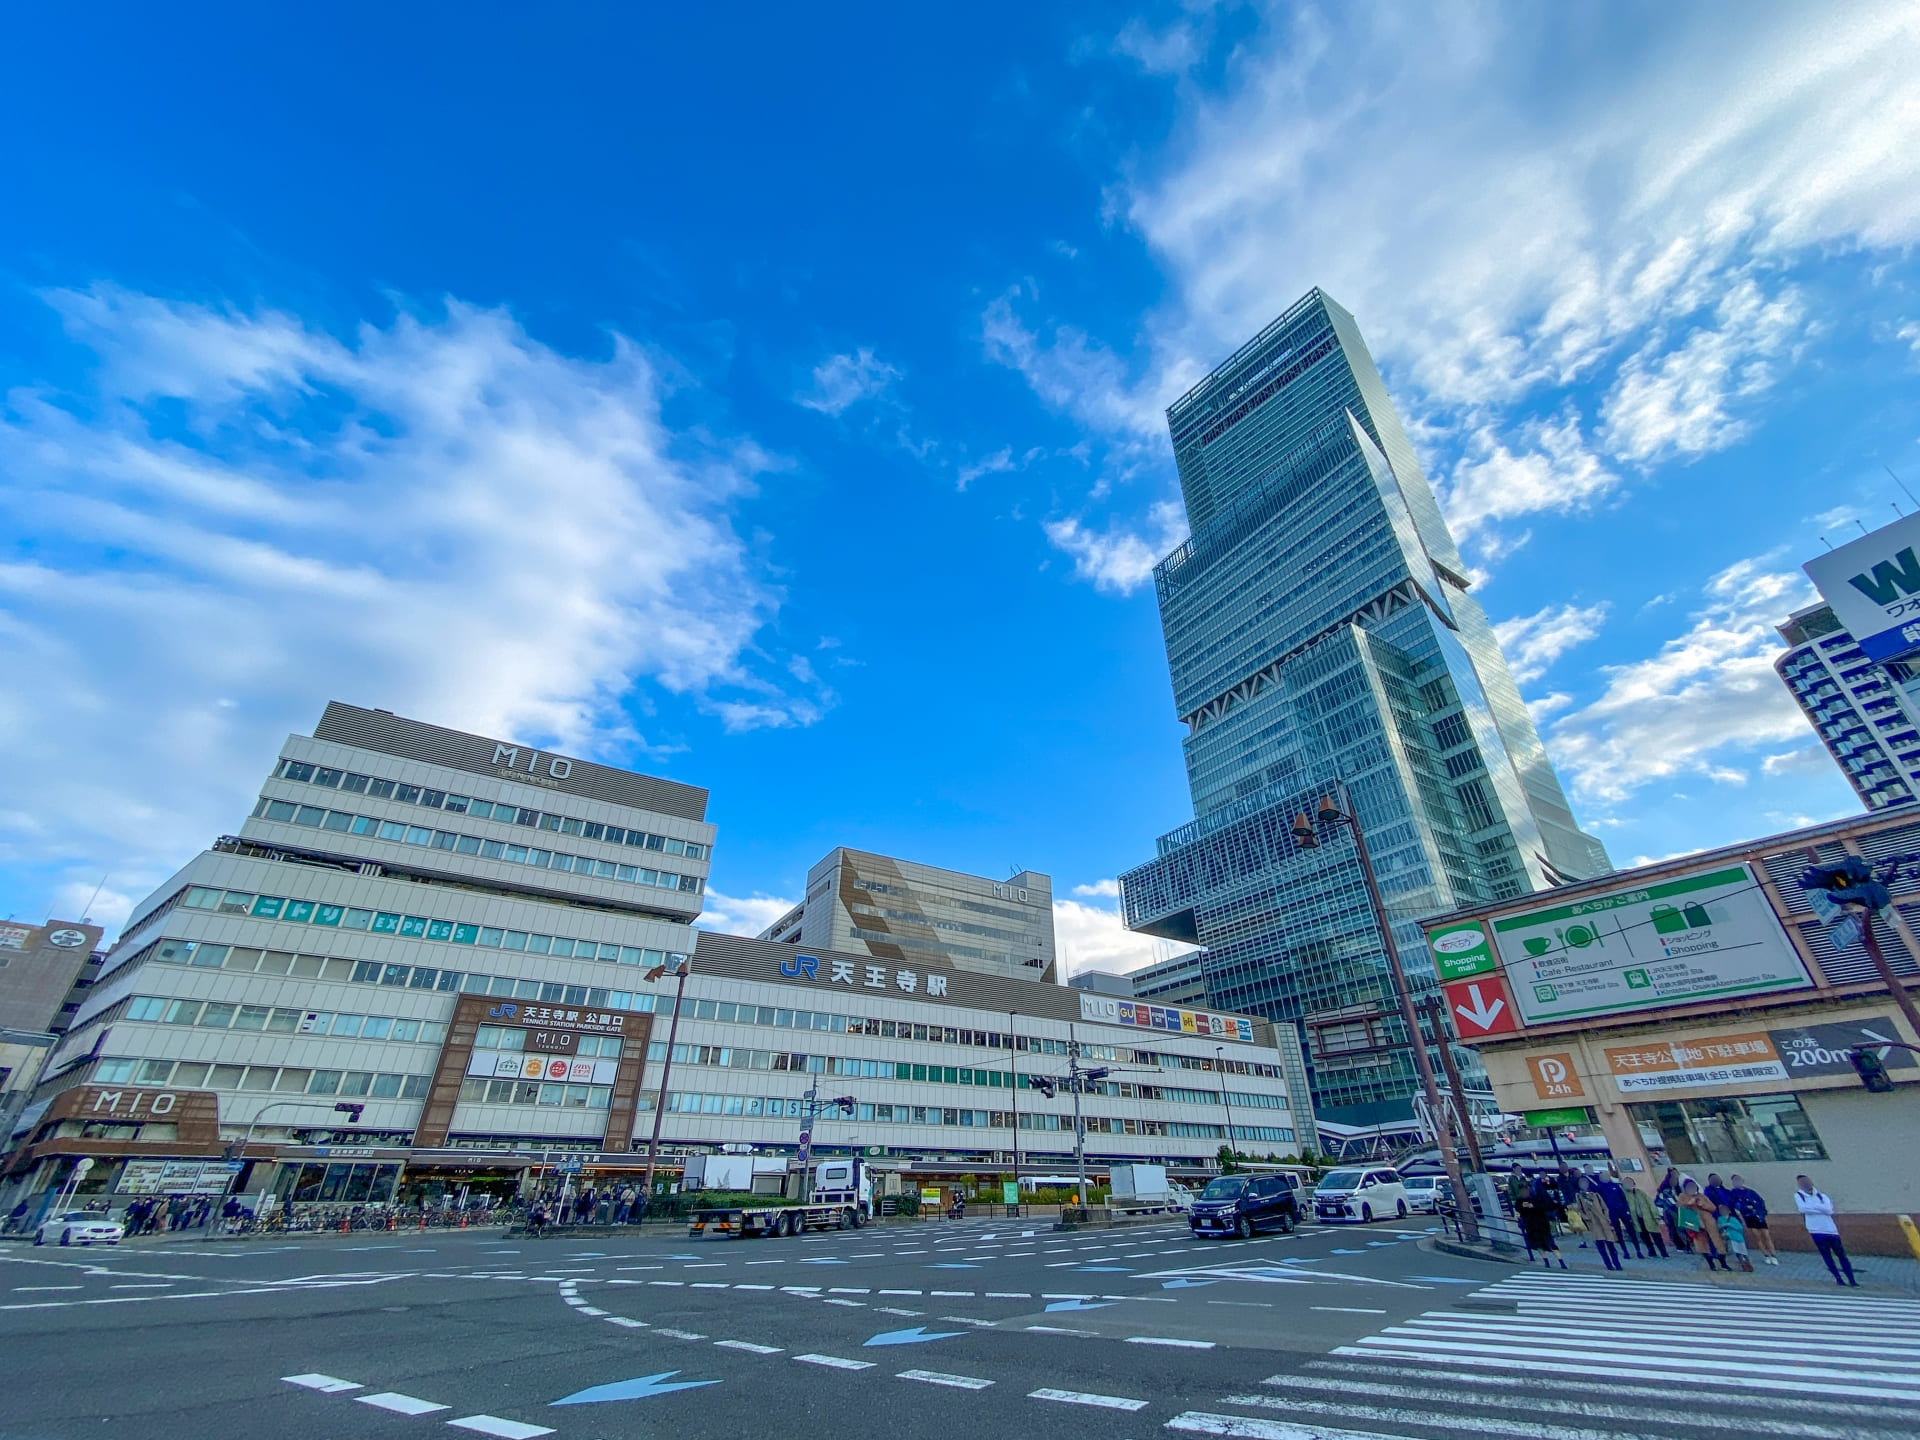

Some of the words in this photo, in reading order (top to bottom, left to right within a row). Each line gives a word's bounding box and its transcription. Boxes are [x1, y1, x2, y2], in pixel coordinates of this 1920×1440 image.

[491, 743, 573, 780] MIO
[992, 882, 1028, 902] MIO
[259, 899, 340, 922] ニトリ
[375, 917, 465, 939] EXPRESS
[1666, 929, 1711, 944] ショッピング
[1670, 941, 1719, 955] Shopping
[1443, 954, 1486, 977] Shopping
[1457, 963, 1476, 982] mall
[780, 954, 820, 980] JR
[830, 961, 948, 998] 天王寺駅
[490, 1003, 519, 1018] JR
[524, 1006, 579, 1022] 天王寺駅
[585, 1012, 624, 1026] 公園口
[1084, 998, 1116, 1017] MIO
[1120, 1007, 1134, 1019] GU
[522, 1017, 549, 1026] TENNOJI
[549, 1019, 575, 1029] STATION
[576, 1023, 605, 1032] PARKSIDE
[535, 1032, 571, 1046] MIO
[1780, 1037, 1820, 1050] この先
[1786, 1047, 1854, 1067] 200m
[1538, 1058, 1566, 1083] P
[1546, 1083, 1572, 1095] 24h
[93, 1090, 176, 1114] MIO
